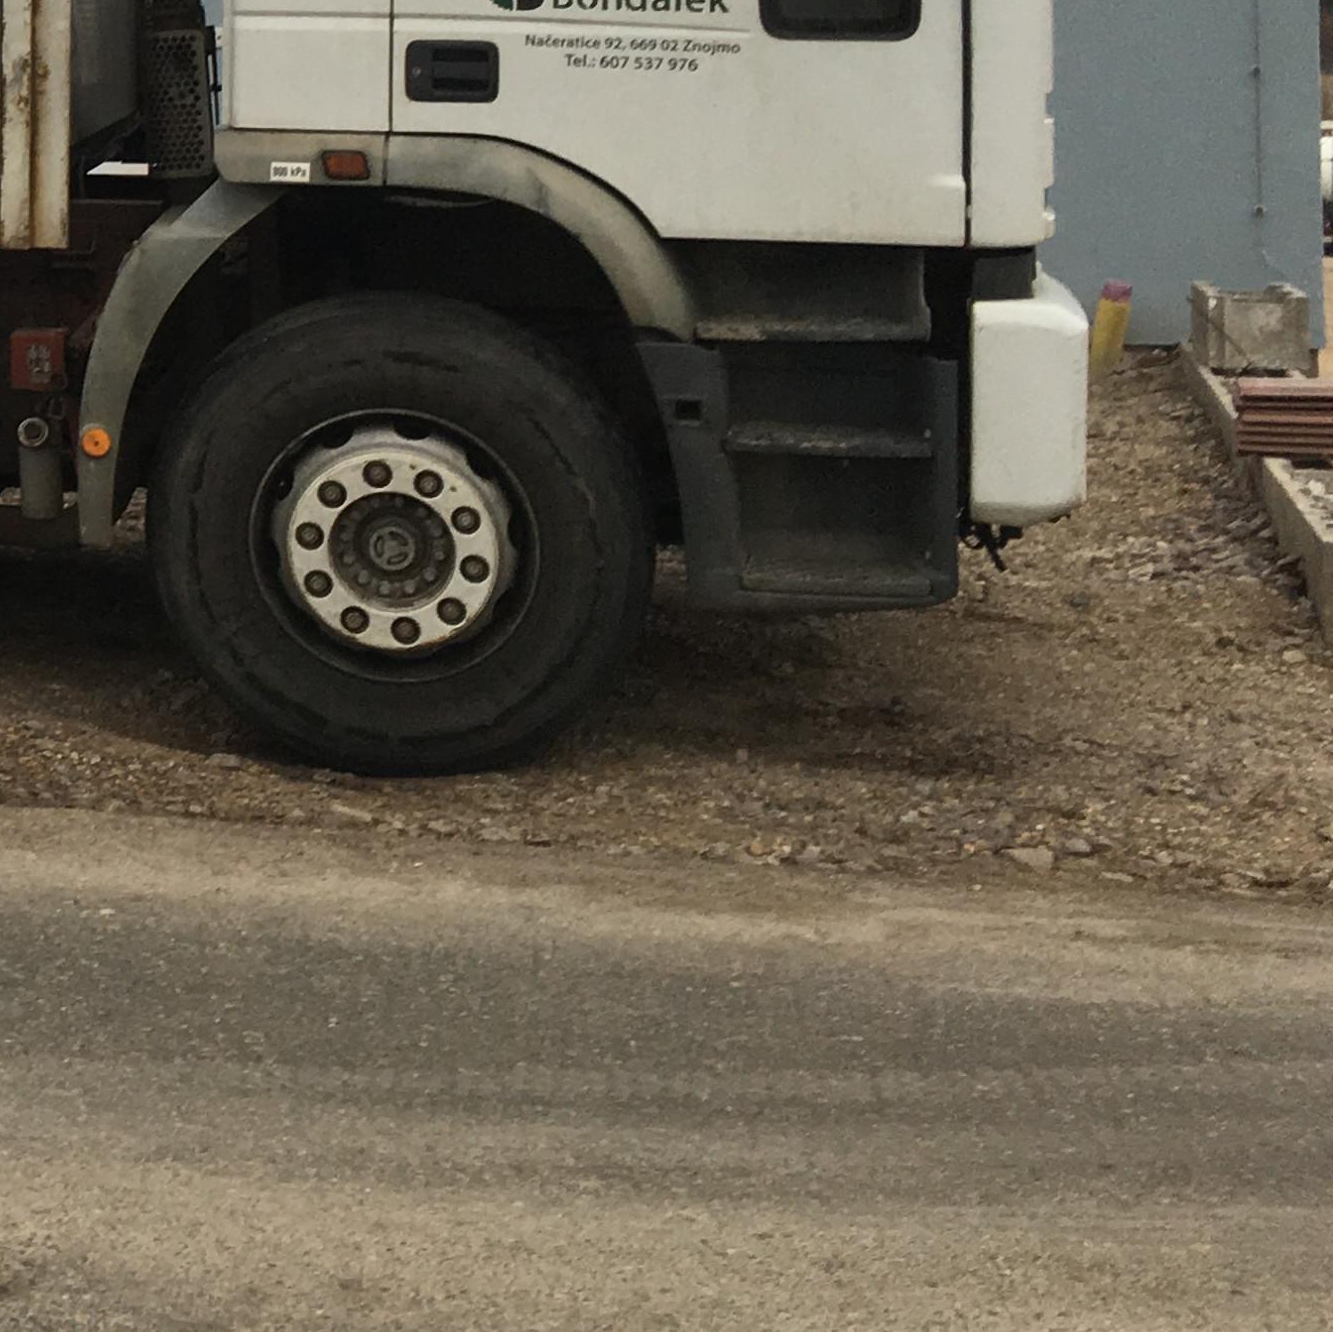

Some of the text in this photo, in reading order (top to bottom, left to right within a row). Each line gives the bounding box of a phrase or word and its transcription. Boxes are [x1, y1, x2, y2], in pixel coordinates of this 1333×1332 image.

[525, 35, 740, 55] Načeratice 92, 669 02 Znojmo
[565, 54, 698, 71] Tel.: 607 537 976
